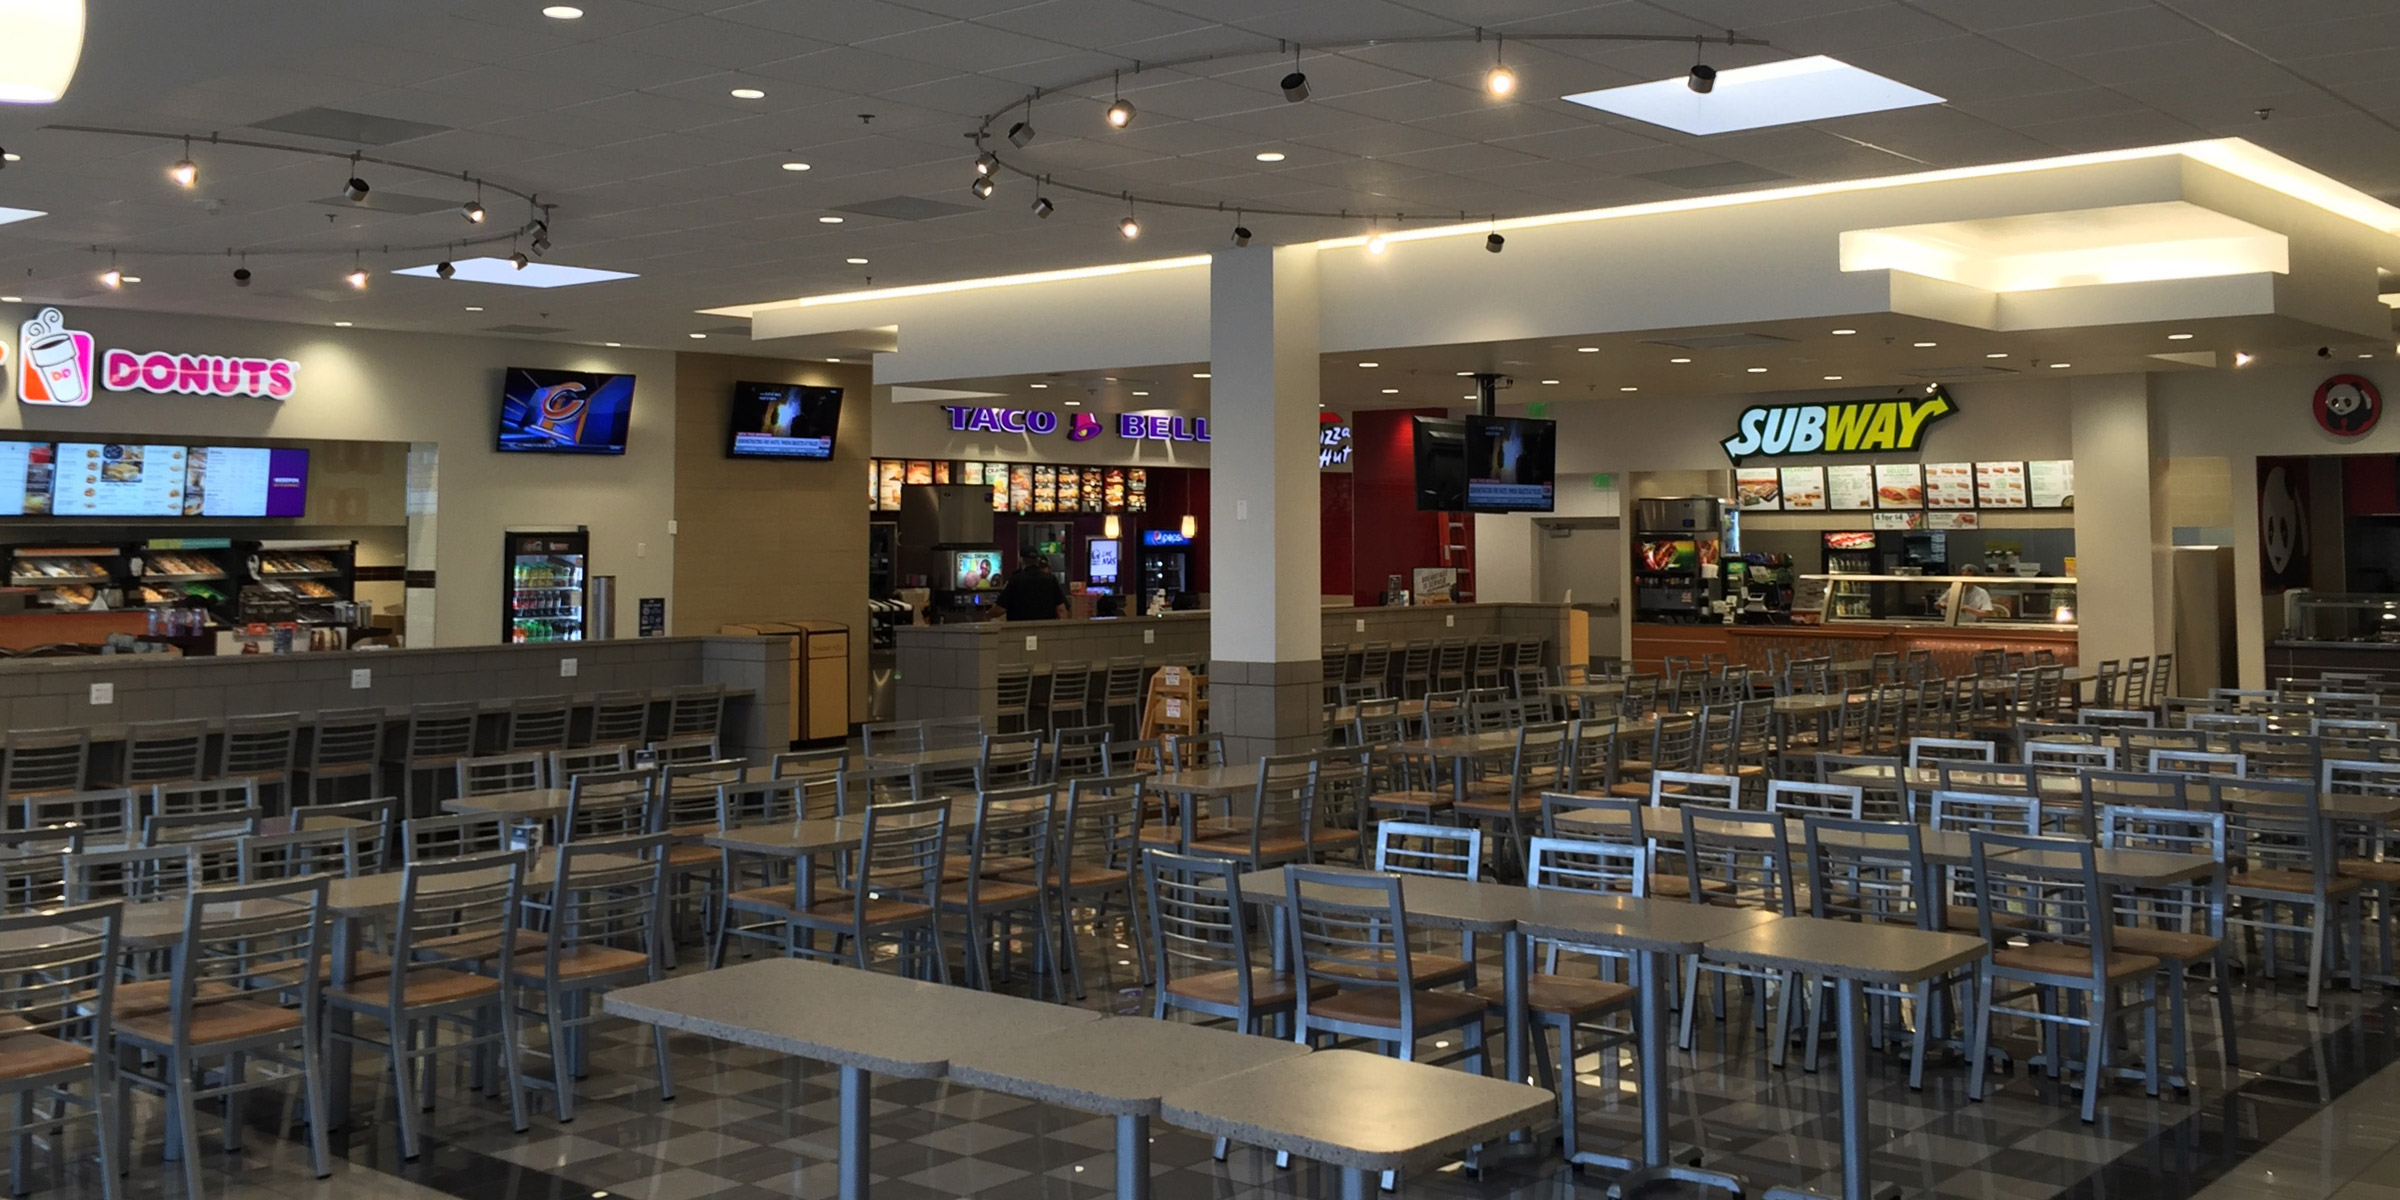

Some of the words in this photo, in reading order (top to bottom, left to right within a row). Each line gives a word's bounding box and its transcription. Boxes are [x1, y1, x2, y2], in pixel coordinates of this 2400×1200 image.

[107, 350, 296, 397] DONUTS
[946, 405, 1059, 434] TACO
[1119, 412, 1212, 443] BELL
[1725, 395, 1949, 459] SUBWAY
[1319, 426, 1352, 446] izza
[1319, 445, 1353, 469] Hut
[1874, 513, 1881, 521] 4
[1882, 513, 1894, 521] for
[1895, 513, 1904, 521] $4
